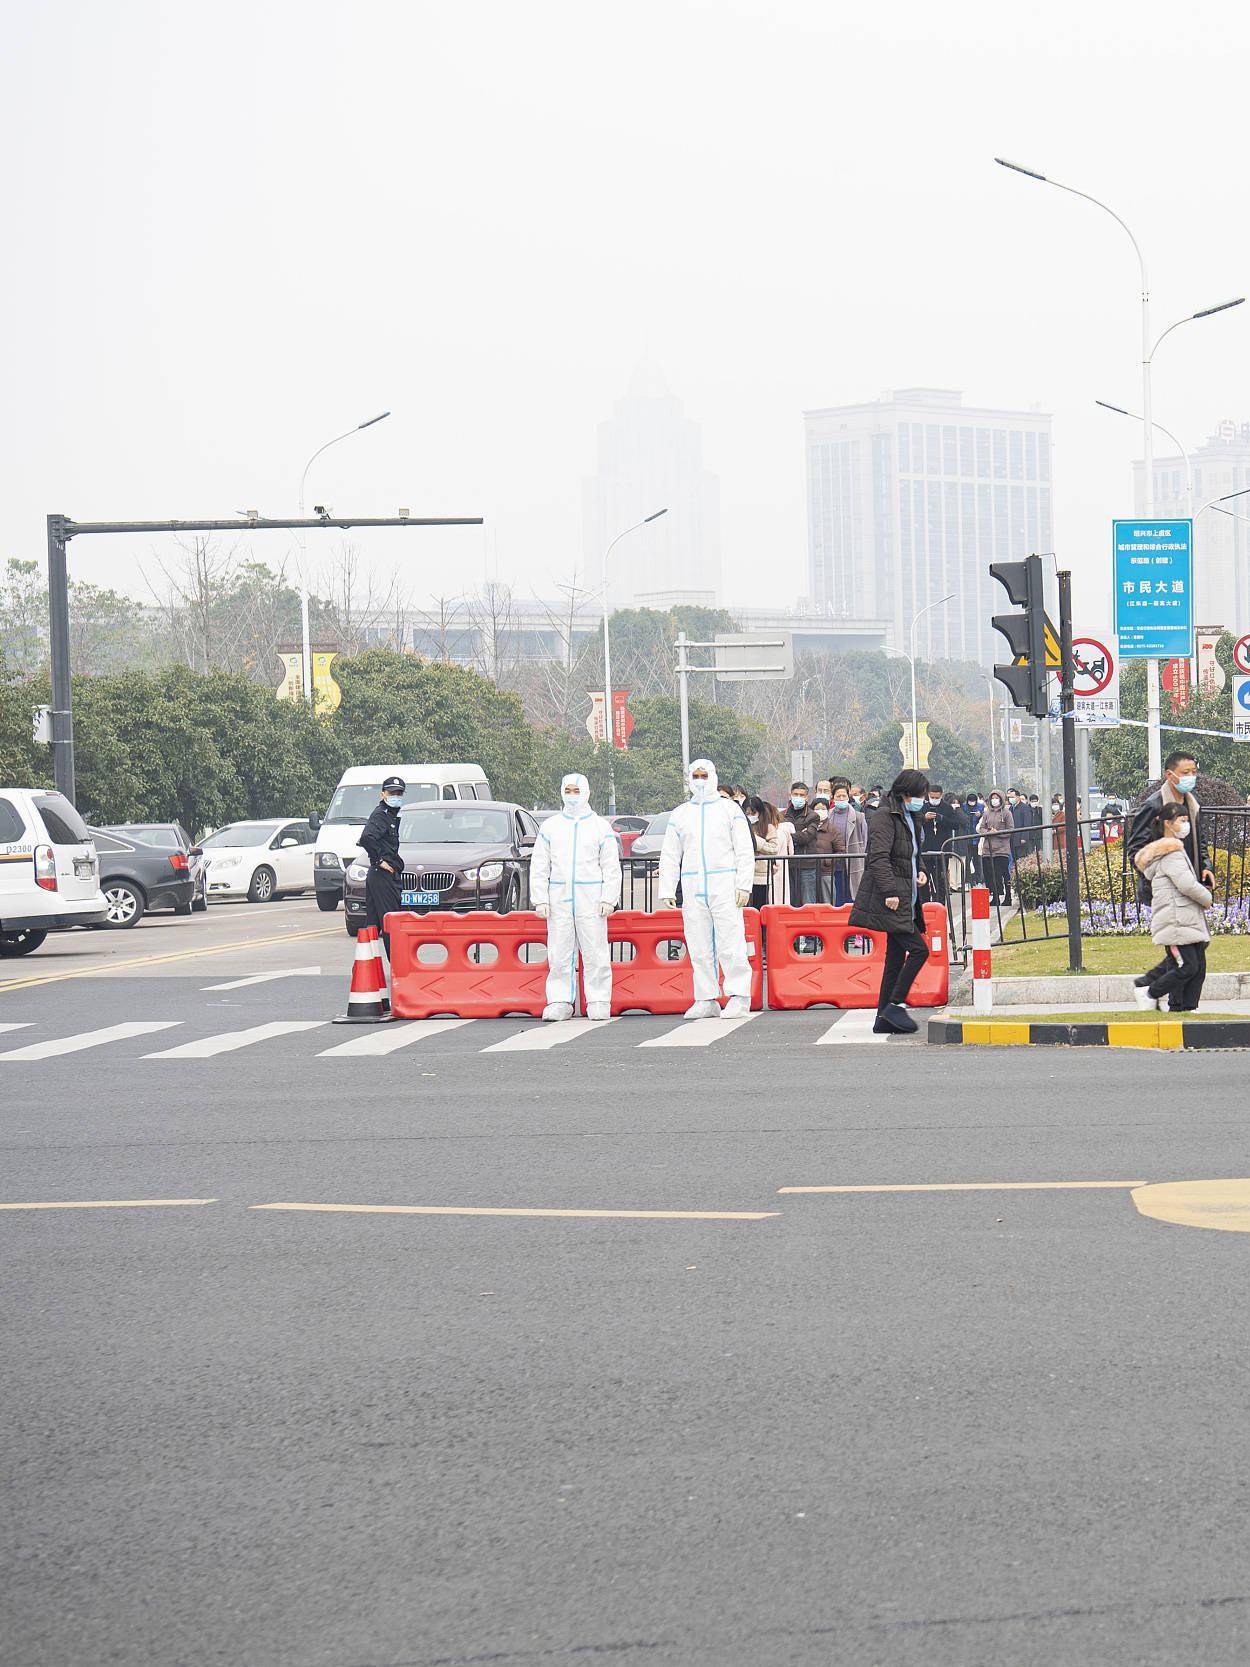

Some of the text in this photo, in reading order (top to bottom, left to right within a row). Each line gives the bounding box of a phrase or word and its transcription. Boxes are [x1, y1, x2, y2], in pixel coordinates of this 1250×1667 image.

[1122, 580, 1185, 594] 市民大道
[6, 845, 32, 853] D2300
